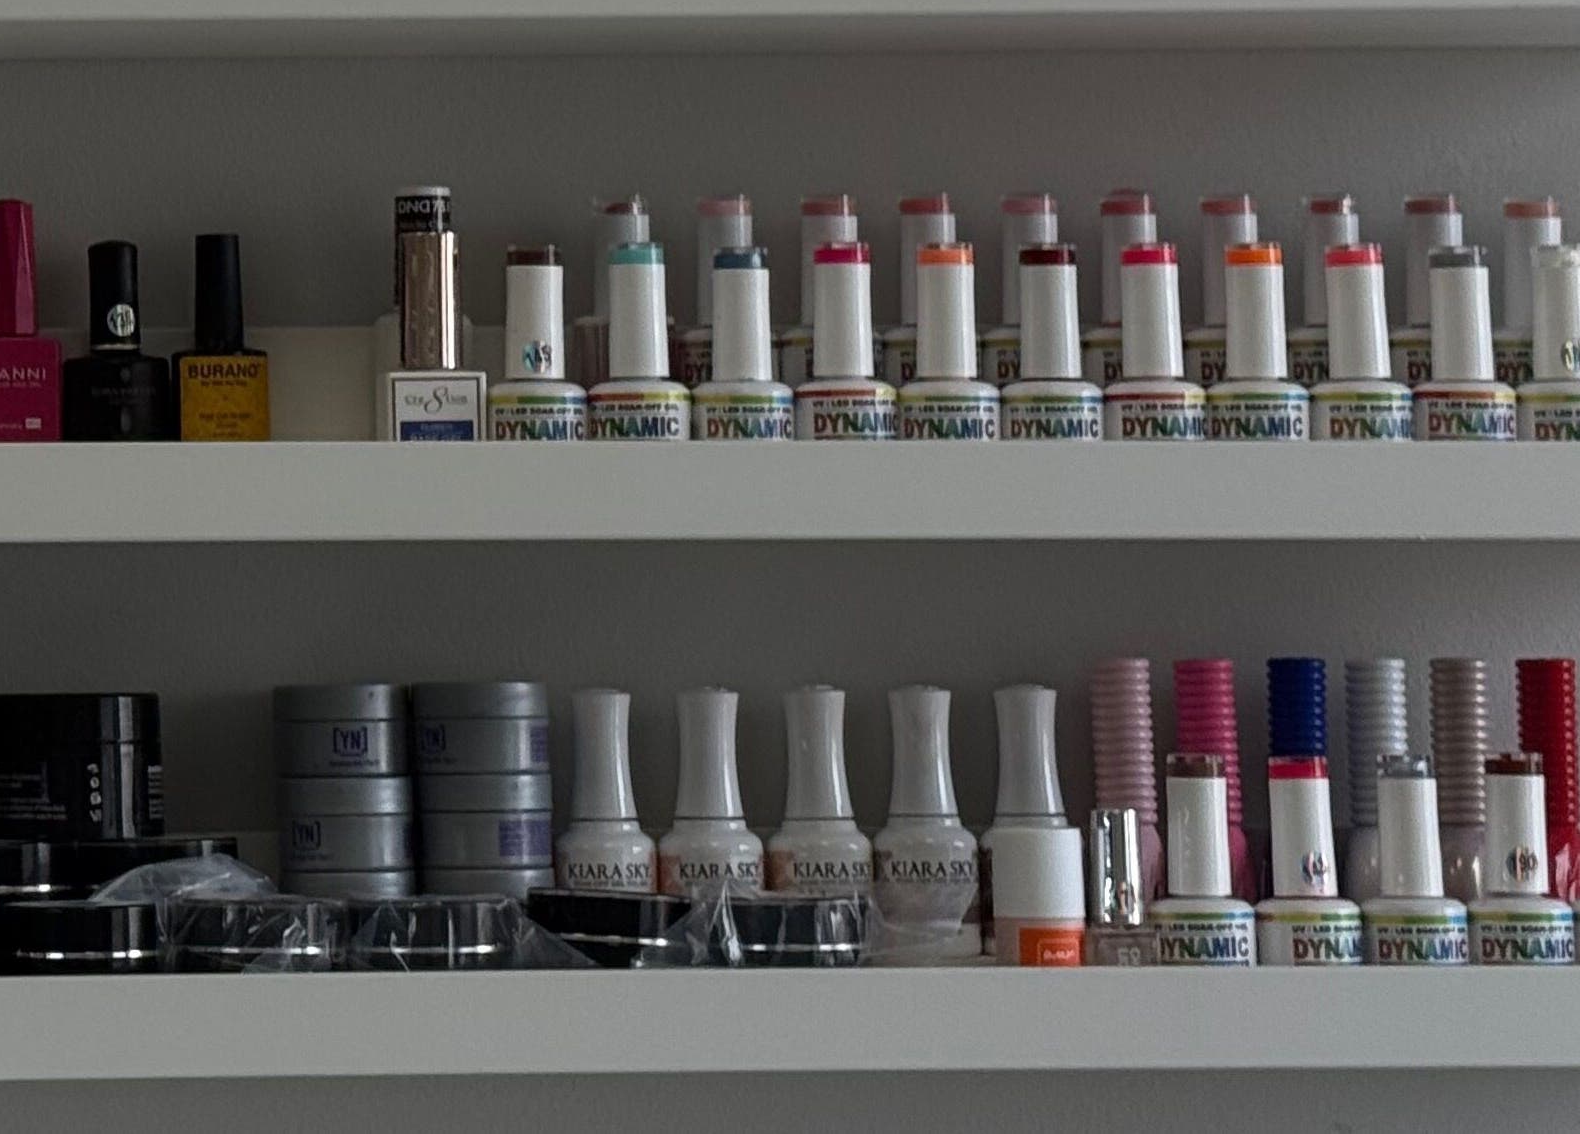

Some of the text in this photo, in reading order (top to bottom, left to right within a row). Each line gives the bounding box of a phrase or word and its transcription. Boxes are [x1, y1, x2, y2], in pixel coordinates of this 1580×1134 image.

[188, 362, 258, 378] BURANO
[495, 419, 583, 439] DYNAMIC
[591, 417, 679, 436] DYNAMIC
[707, 418, 792, 438] DYNAMIC
[904, 418, 994, 438] DYNAMIC
[1011, 418, 1099, 437] DYNAMIC
[1212, 417, 1303, 437] DYNAMIC
[1429, 413, 1515, 434] DYNAMIC
[568, 862, 622, 879] KIARA
[680, 863, 734, 879] KIARA
[794, 861, 850, 878] KIARA
[892, 861, 947, 877] KIARA
[1378, 937, 1468, 960] DYNAMIC
[1482, 936, 1574, 959] DYNAMIC
